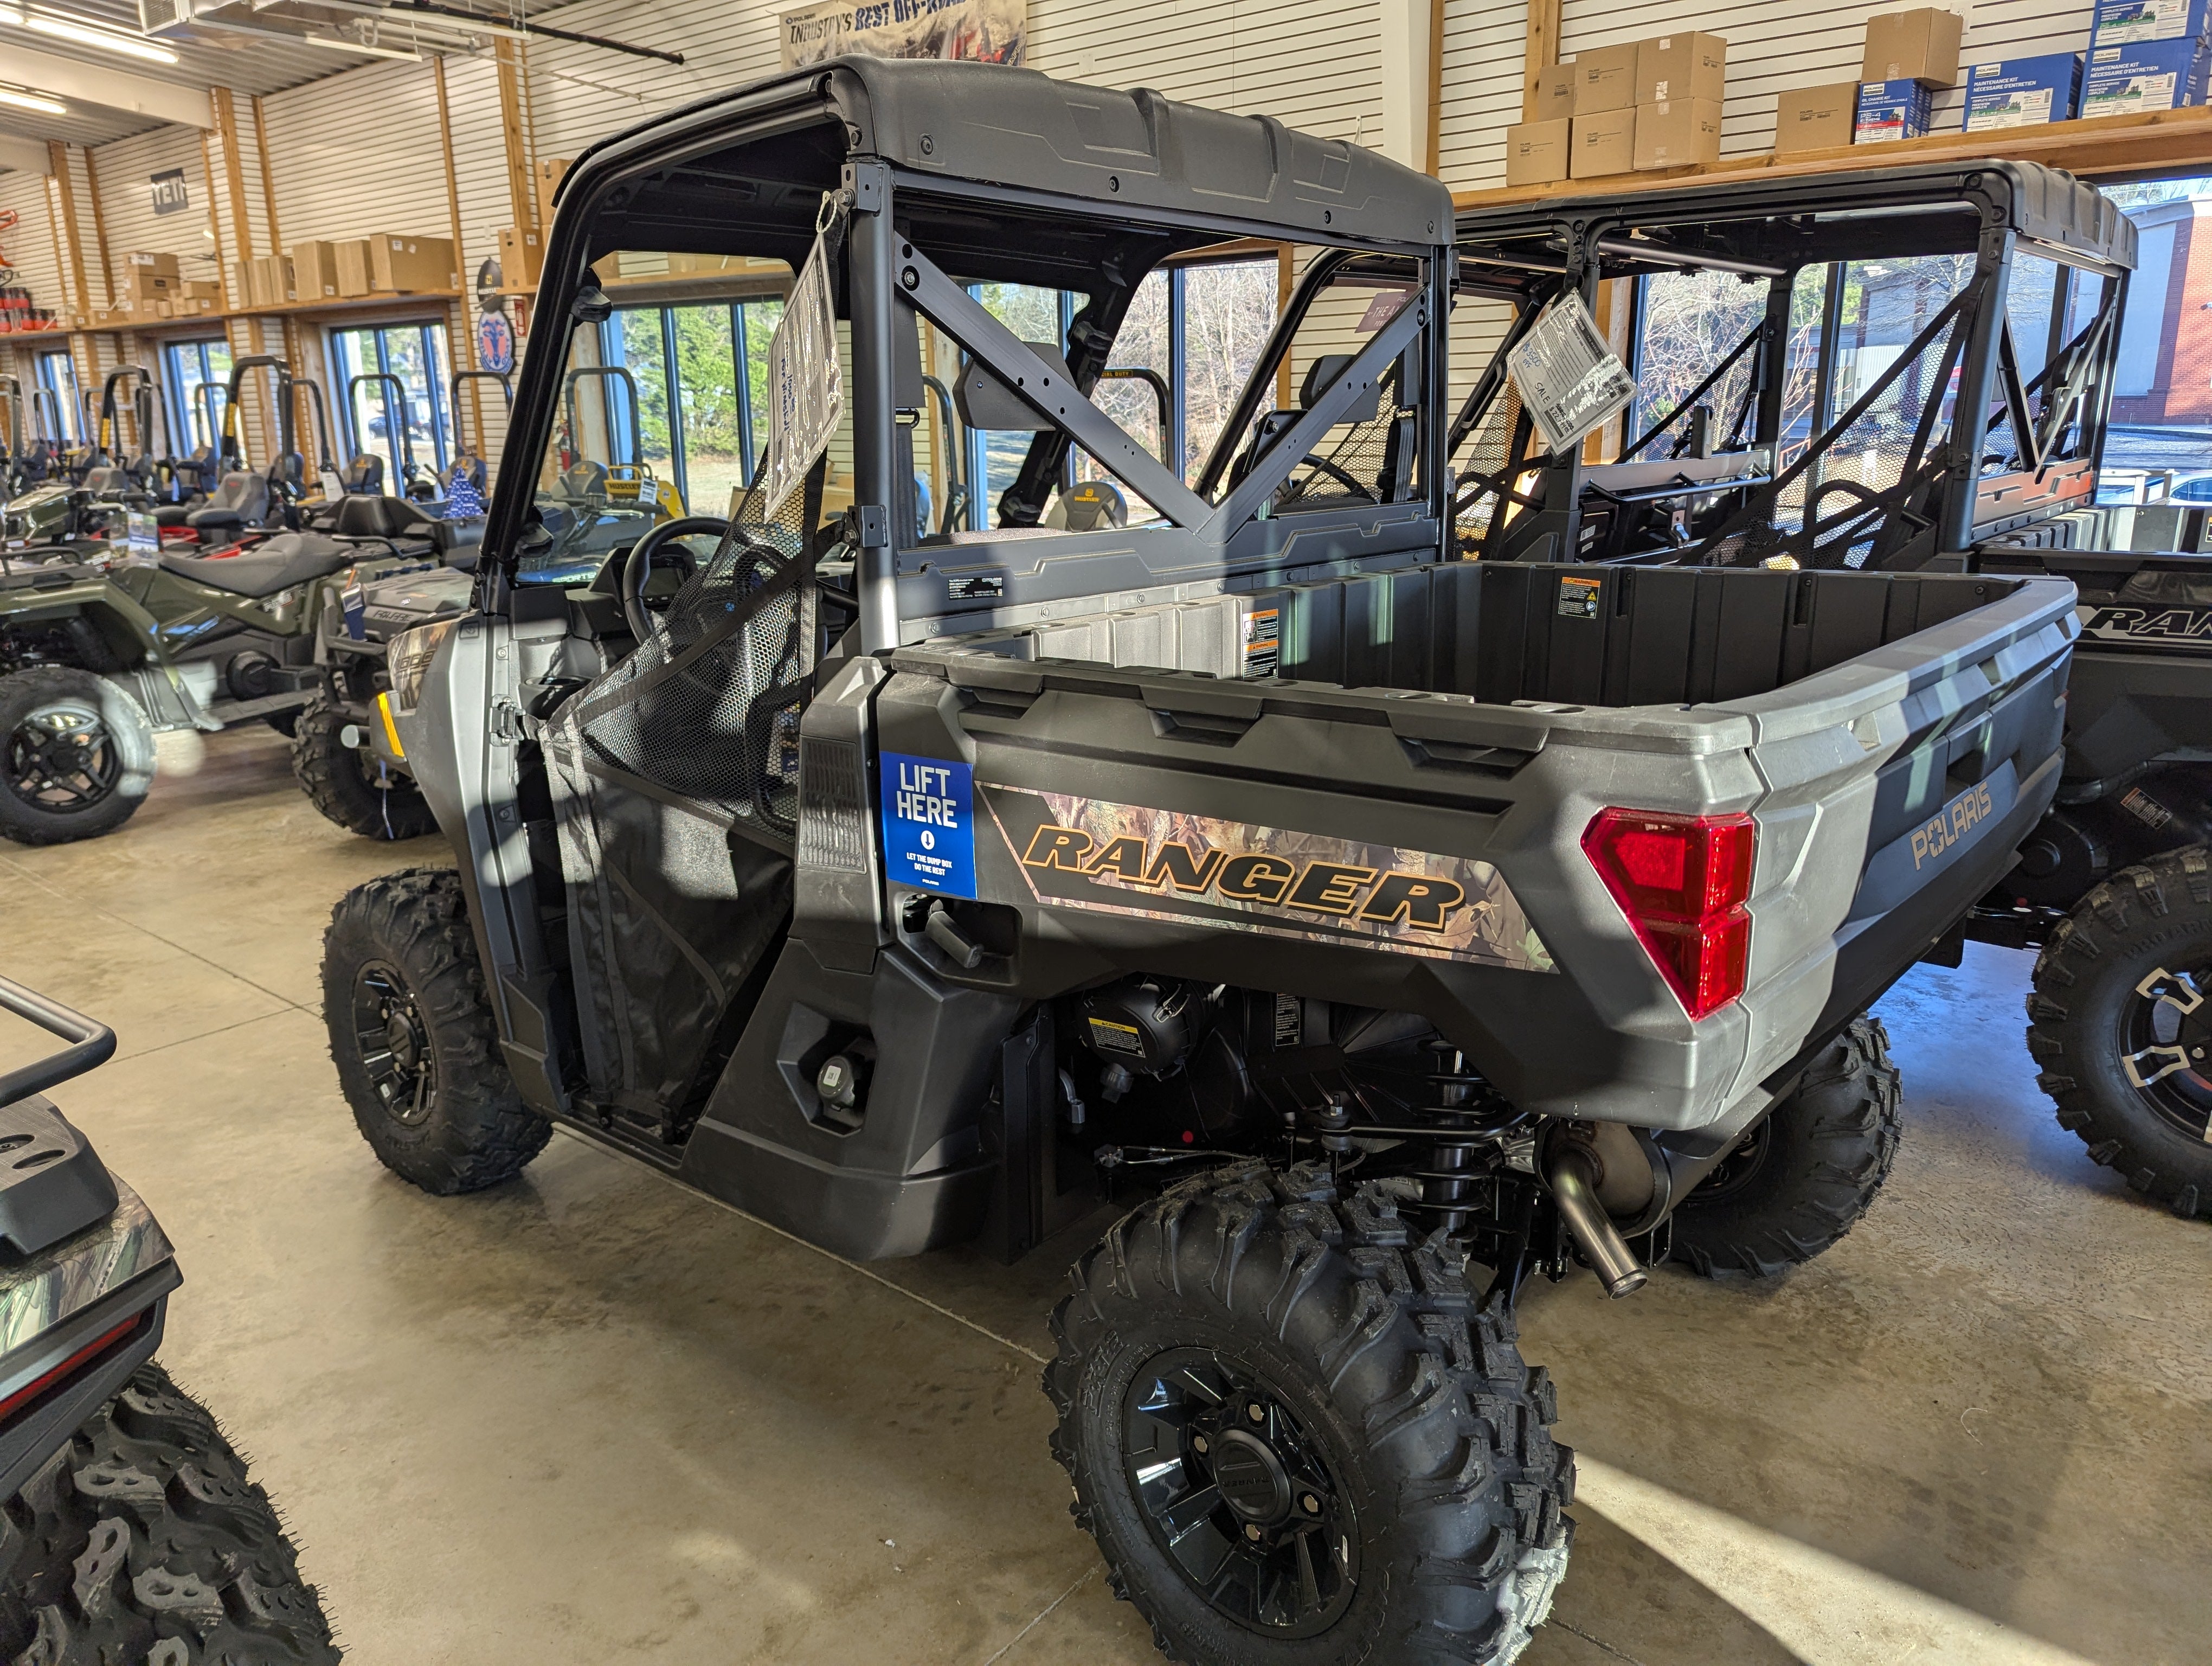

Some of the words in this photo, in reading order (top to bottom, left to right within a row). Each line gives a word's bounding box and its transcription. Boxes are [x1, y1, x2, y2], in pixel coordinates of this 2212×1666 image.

[794, 13, 816, 23] POLARIS
[854, 3, 890, 31] BEST
[2090, 69, 2123, 78] NÉCESSAIRE
[2124, 66, 2159, 74] D'ENTRETIEN
[2091, 63, 2130, 72] MAINTENANCE
[1973, 78, 2009, 87] MAINTENANCE
[1973, 84, 2004, 93] NÉCESSAIRE
[2004, 81, 2037, 89] D'ENTRETIEN
[151, 176, 185, 206] YETI
[1373, 306, 1389, 318] THE
[1522, 341, 1541, 367] $3500
[1522, 358, 1532, 369] OFF
[1534, 382, 1551, 405] SALE
[552, 571, 597, 582] SPORTS
[899, 762, 950, 797] LIFT
[896, 791, 958, 829] HERE
[1911, 780, 1992, 871] POLARIS
[906, 852, 916, 861] LET
[916, 854, 927, 863] THE
[927, 856, 941, 866] DUMP
[941, 859, 953, 869] BOX
[914, 862, 922, 871] DO
[921, 864, 932, 873] THE
[932, 866, 946, 876] REST
[1023, 824, 1466, 933] RANGER
